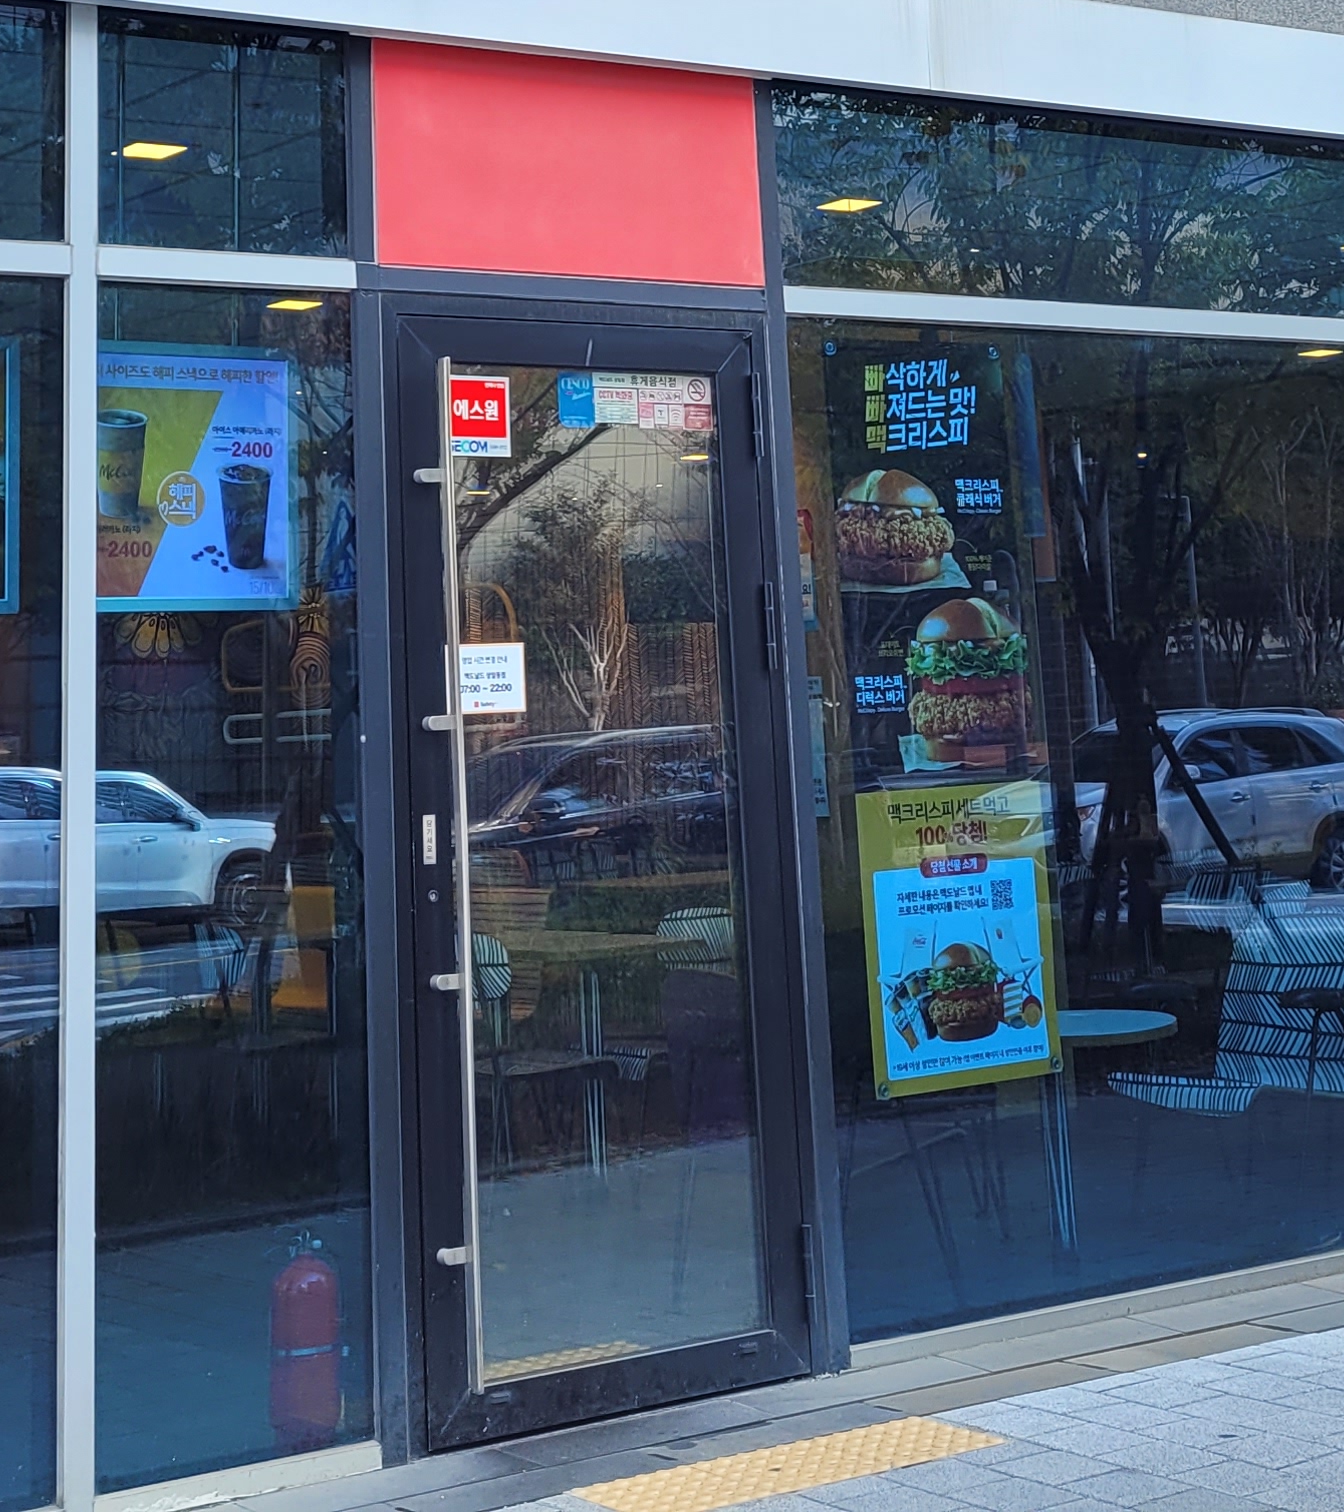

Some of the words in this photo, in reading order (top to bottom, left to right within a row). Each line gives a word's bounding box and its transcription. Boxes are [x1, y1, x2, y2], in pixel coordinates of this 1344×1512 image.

[105, 364, 151, 380] 사이즈도
[153, 365, 174, 381] 해피
[175, 367, 220, 382] 스낵으로
[864, 358, 948, 393] 빠삭하게
[630, 376, 677, 388] 휴게음식점
[453, 399, 500, 422] 에스원
[865, 390, 946, 423] 빠져드는
[949, 385, 976, 417] 맛!
[865, 416, 969, 455] 맥크리스피
[231, 442, 274, 459] 2400
[955, 478, 1000, 494] 맥크리스피
[984, 493, 1002, 507] 버거
[107, 541, 153, 558] 2400
[460, 684, 481, 694] 07:00
[489, 683, 513, 693] 22:00
[855, 674, 903, 691] 맥크리스피
[856, 691, 885, 706] 디럭스
[886, 690, 905, 705] 버거
[887, 798, 955, 825] 맥크리스피
[956, 798, 983, 818] 세트
[982, 796, 1011, 817] 먹고
[915, 825, 954, 846] 100%
[952, 820, 988, 847] 당첨!
